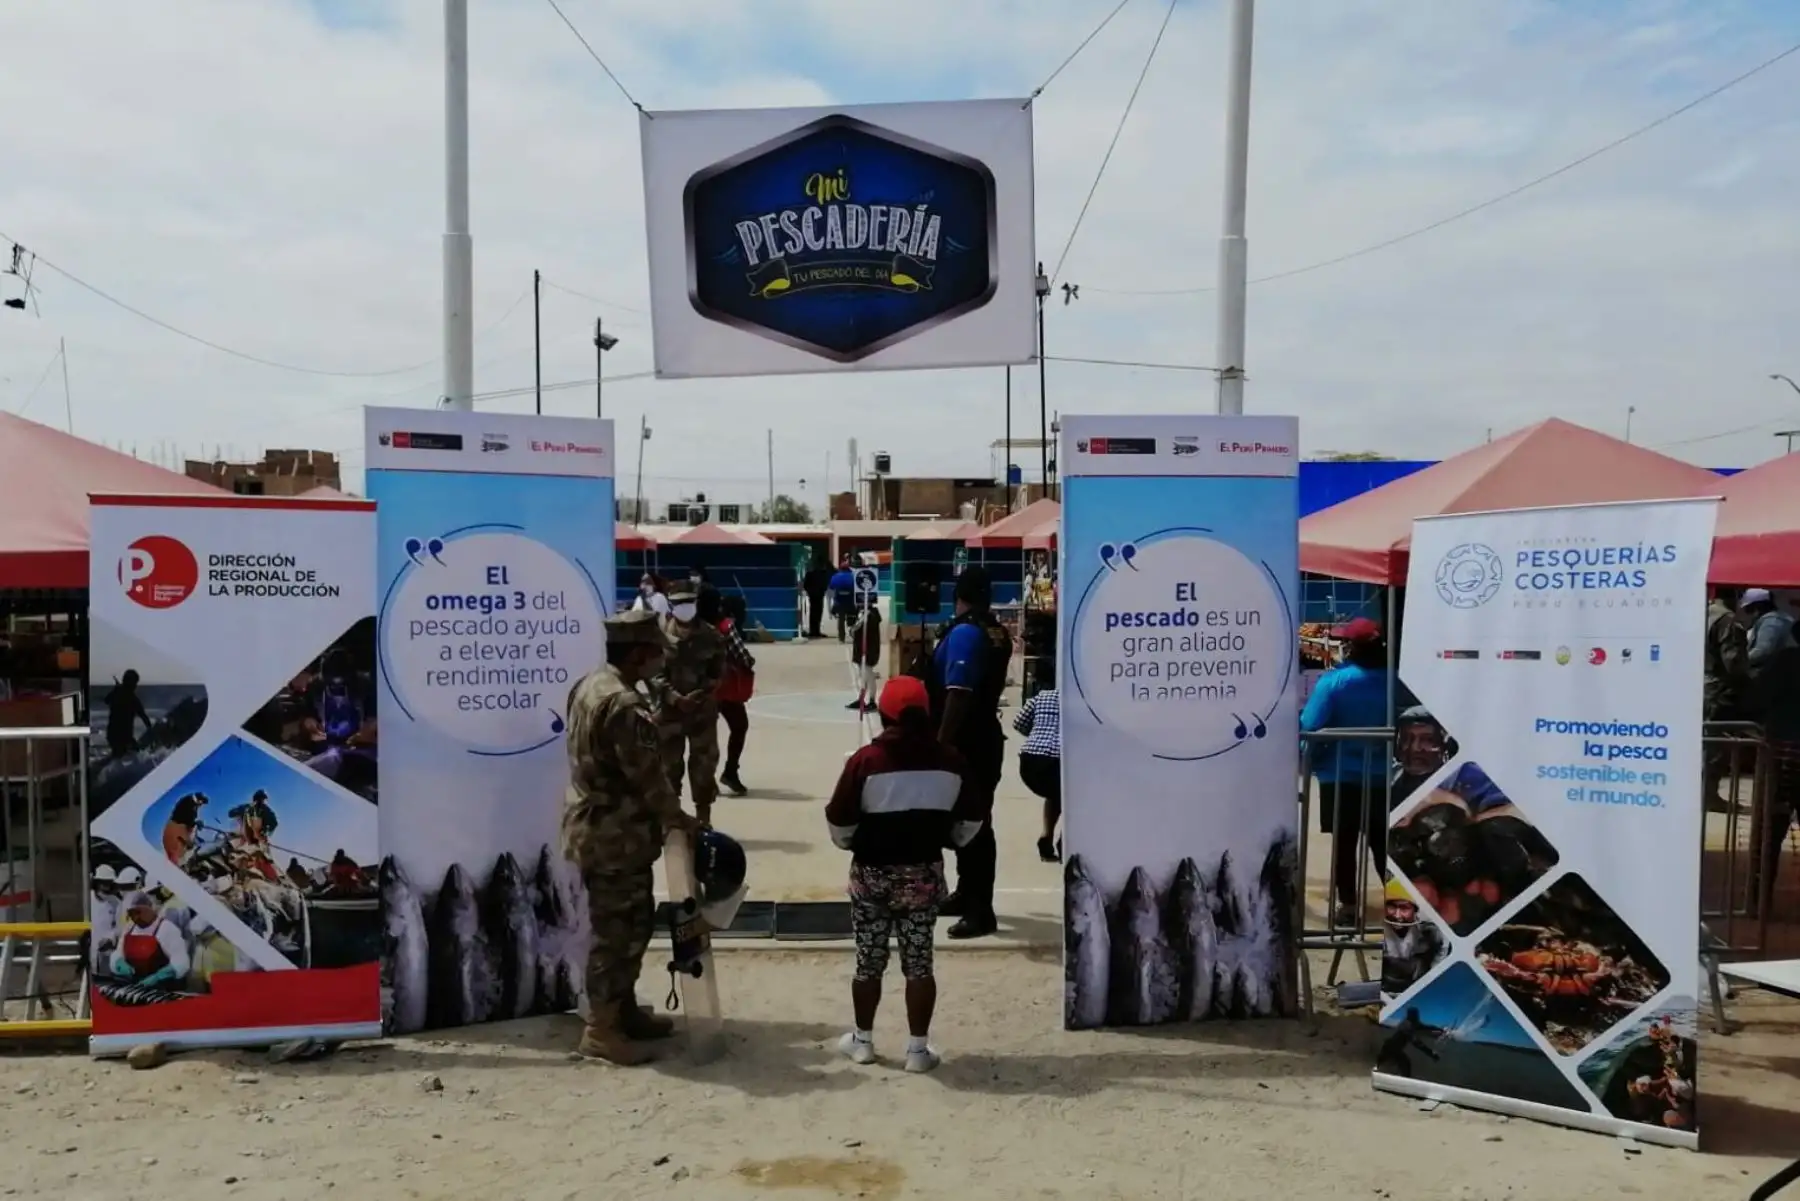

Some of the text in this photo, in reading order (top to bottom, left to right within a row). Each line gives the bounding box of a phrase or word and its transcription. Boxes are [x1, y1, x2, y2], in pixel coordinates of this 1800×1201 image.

[735, 203, 942, 265] PESCADERÍA
[793, 272, 808, 283] TU
[810, 266, 853, 280] PESCADO
[208, 552, 296, 568] DIRECCIÓN
[1516, 541, 1677, 570] PESQUERÍAS
[208, 569, 316, 582] REGIONAL DE
[486, 566, 509, 585] El
[1515, 570, 1647, 590] COSTERAS
[208, 581, 340, 597] LA PRODUCCIÓN
[1176, 582, 1198, 602] El
[426, 591, 566, 614] omega 3 del
[409, 615, 581, 640] pescado ayuda
[1105, 608, 1261, 632] pescado es un
[440, 641, 556, 661] a elevar el
[1123, 631, 1245, 657] gran aliado
[426, 665, 569, 686] rendimiento
[1110, 656, 1257, 682] para prevenir
[458, 689, 542, 711] escolar
[1156, 680, 1237, 701] anemia
[1535, 718, 1669, 738] Promoviendo
[1584, 740, 1668, 760] la pesca
[1536, 764, 1666, 785] sostenible en
[1566, 786, 1666, 808] el mundo.
